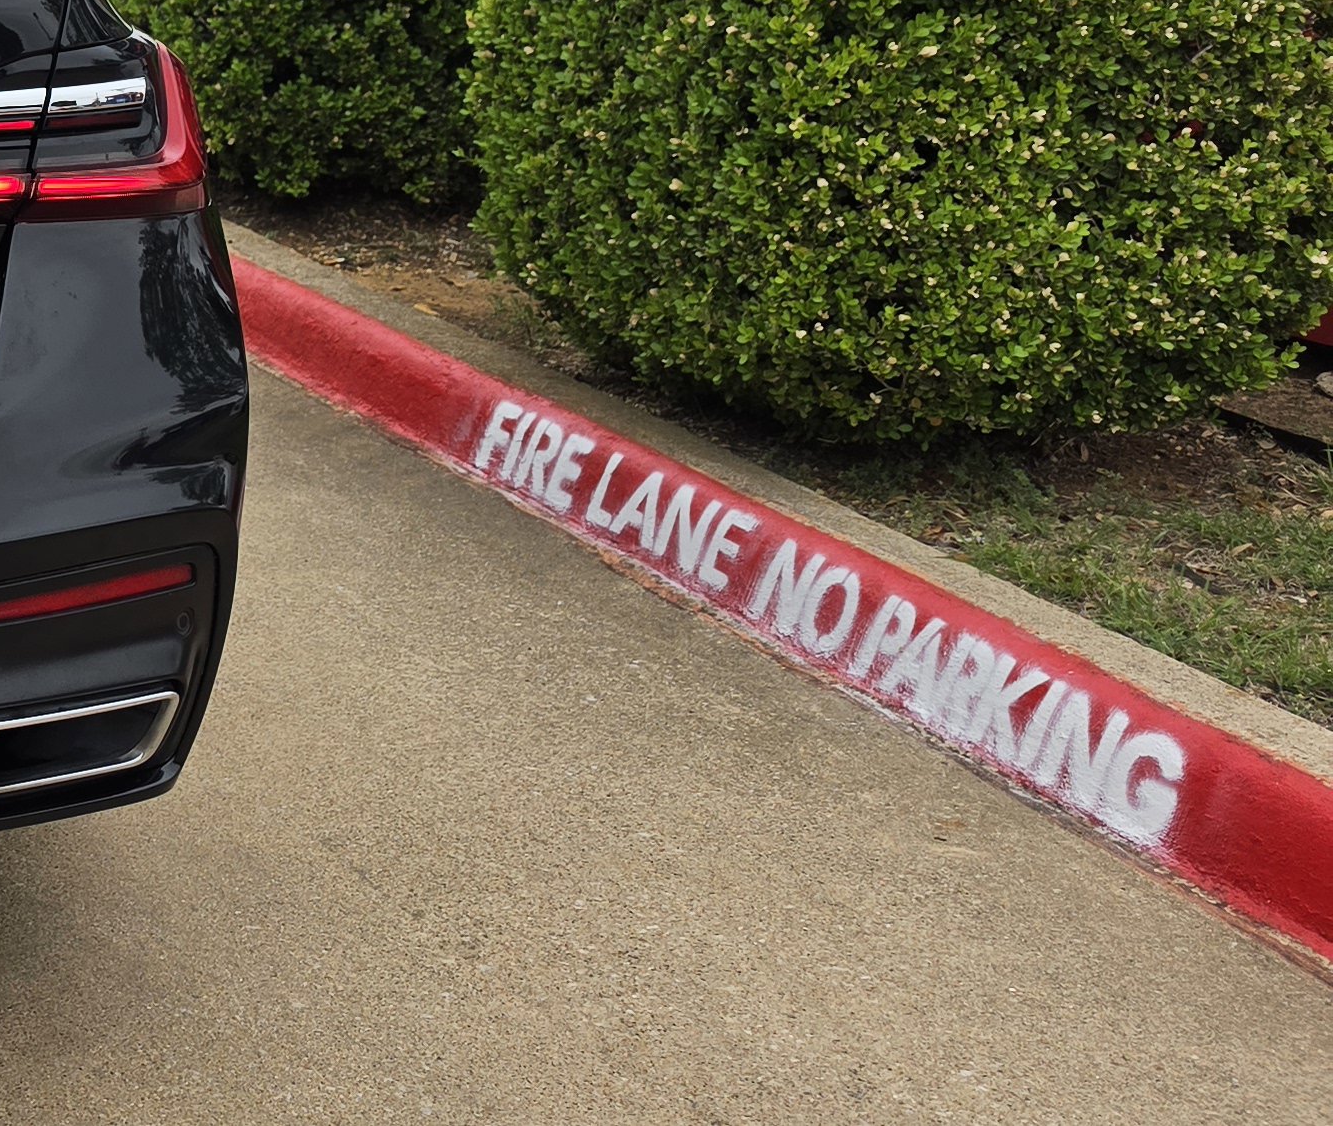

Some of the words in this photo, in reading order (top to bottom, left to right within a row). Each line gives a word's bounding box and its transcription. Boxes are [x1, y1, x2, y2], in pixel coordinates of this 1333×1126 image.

[474, 400, 596, 512] FIRE
[586, 452, 760, 591] LANE
[746, 539, 861, 658] NO
[846, 595, 1184, 846] PARKING
